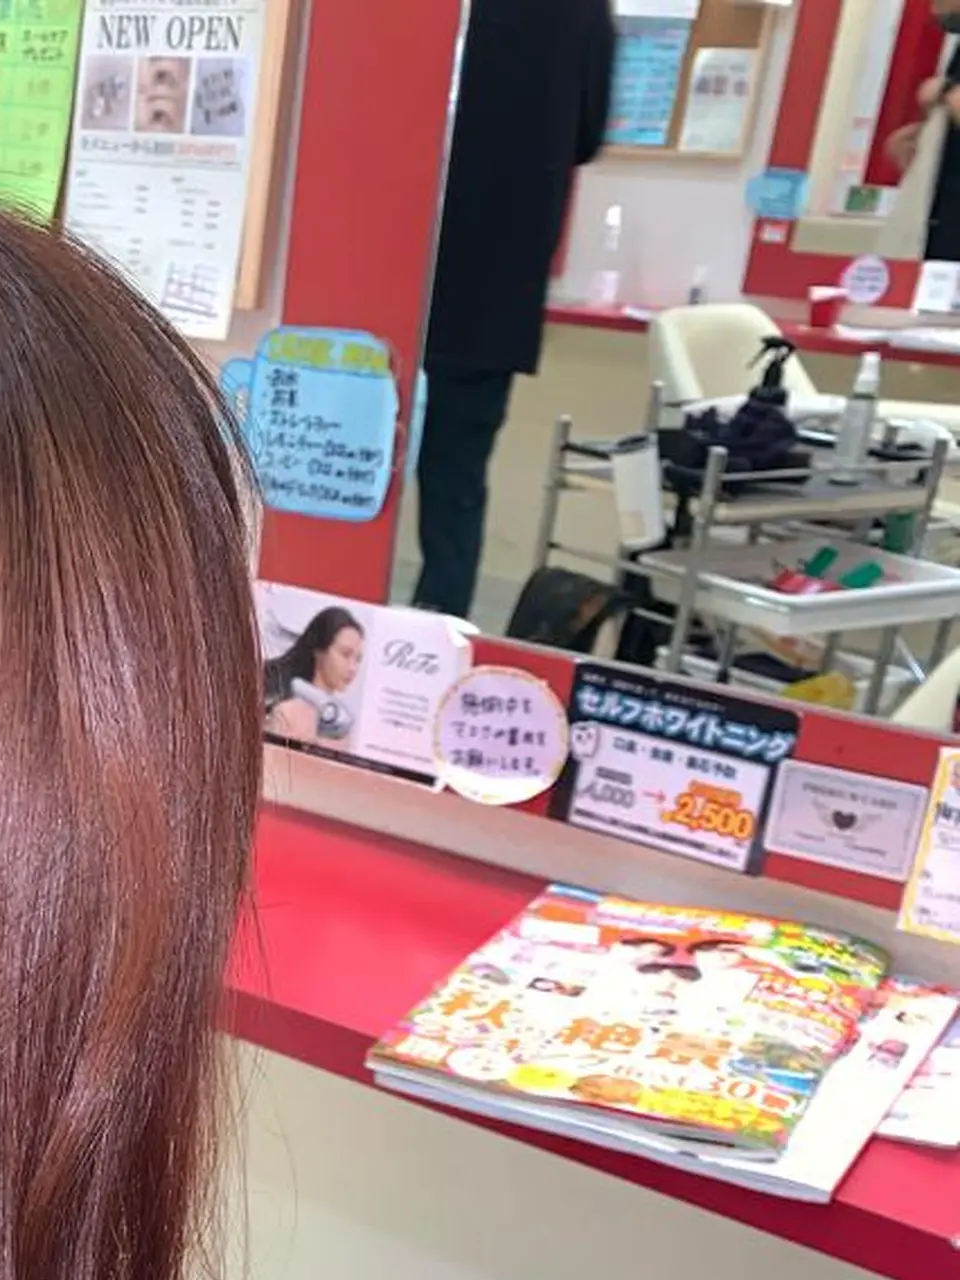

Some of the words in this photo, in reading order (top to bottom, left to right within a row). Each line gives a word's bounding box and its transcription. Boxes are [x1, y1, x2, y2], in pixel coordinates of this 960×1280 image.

[97, 14, 156, 49] NEW
[165, 15, 245, 51] OPEN
[576, 685, 796, 764] セルフホワイトニング
